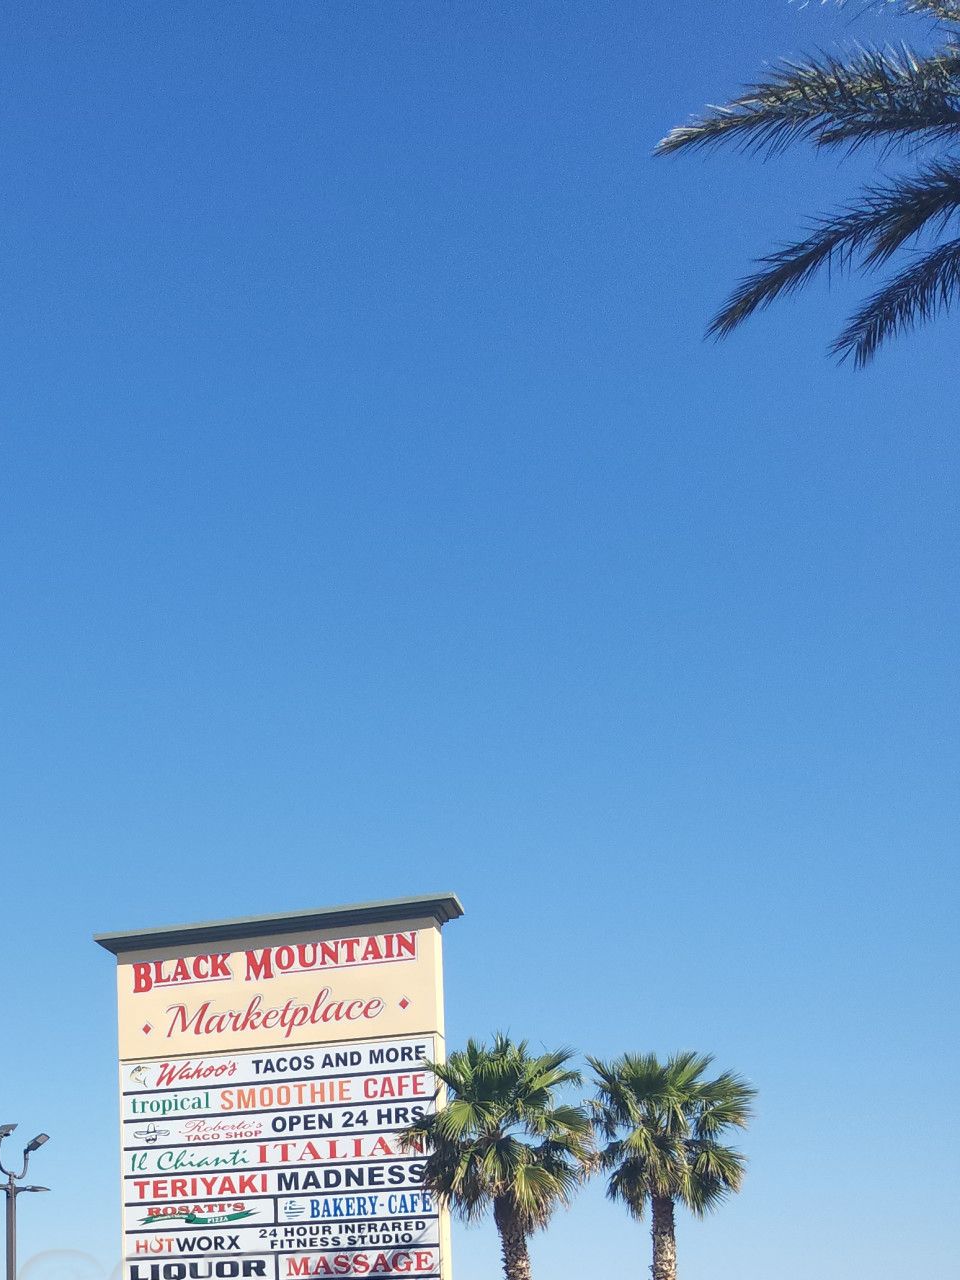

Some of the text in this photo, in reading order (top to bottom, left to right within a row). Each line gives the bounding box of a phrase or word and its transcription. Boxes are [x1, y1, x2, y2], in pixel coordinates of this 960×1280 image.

[133, 932, 417, 993] BLACK MOUNTAIN
[166, 987, 384, 1037] Marketplace
[156, 1045, 426, 1087] Wahoo's TACOS AND MORE
[131, 1074, 426, 1115] tropical SMOOTHIE CAFE
[180, 1119, 263, 1133] Roberto's
[271, 1106, 425, 1133] OPEN 24 HRS
[185, 1129, 262, 1142] TACO SHOP
[157, 1150, 250, 1169] Chianti
[257, 1133, 425, 1164] ITALIAN
[134, 1163, 426, 1199] TERIYAKI MADNESS
[147, 1202, 246, 1216] ROSATI'S
[259, 1220, 427, 1239] 24 HOUR INFRARED
[270, 1233, 413, 1249] FITNESS STUDIO
[286, 1250, 434, 1278] MASSAGE
